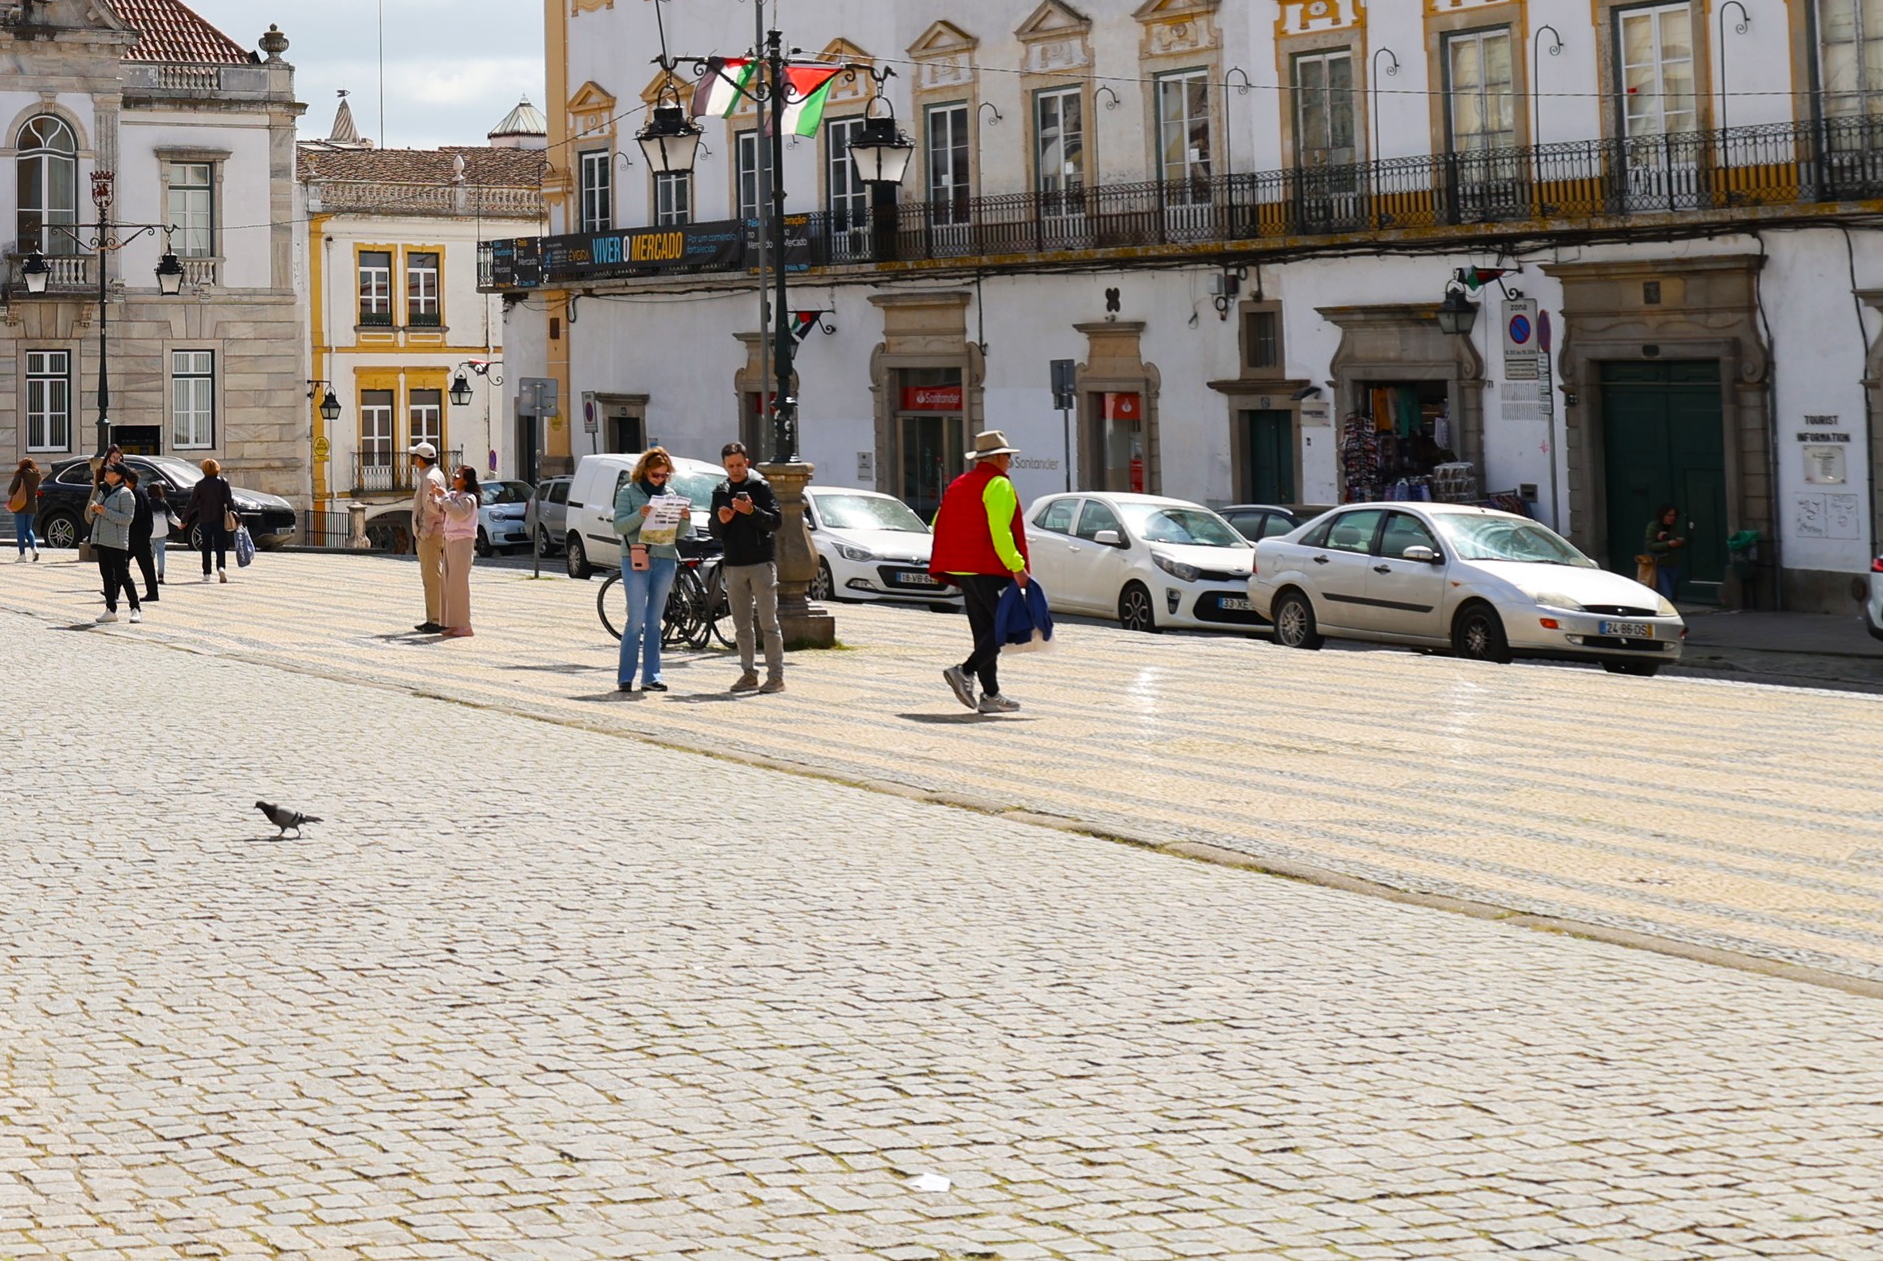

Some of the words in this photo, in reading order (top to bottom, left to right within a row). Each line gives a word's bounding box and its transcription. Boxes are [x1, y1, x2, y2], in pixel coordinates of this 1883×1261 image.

[687, 234, 698, 242] Por
[592, 237, 621, 264] VIVER
[623, 235, 630, 263] O
[631, 232, 683, 261] MERCADO
[925, 392, 960, 404] Santander
[1804, 415, 1838, 425] TOURIST
[1797, 432, 1851, 443] INFORMATION
[1015, 456, 1060, 470] Santander
